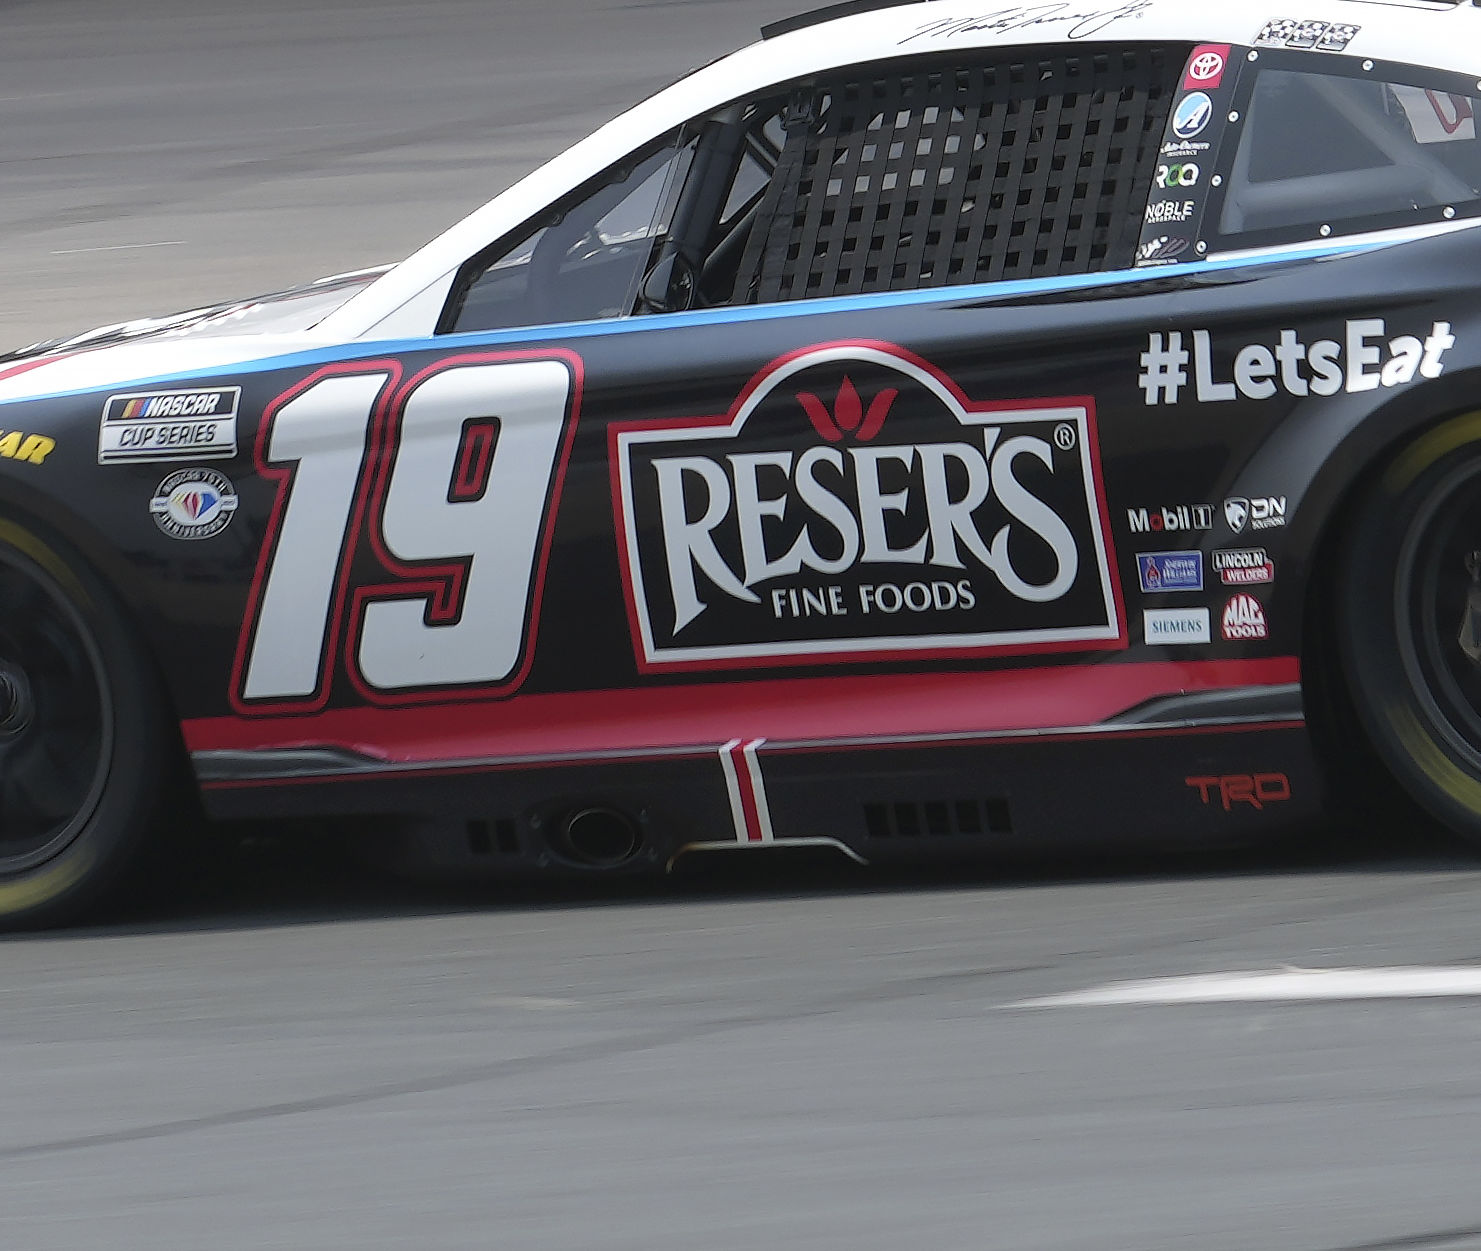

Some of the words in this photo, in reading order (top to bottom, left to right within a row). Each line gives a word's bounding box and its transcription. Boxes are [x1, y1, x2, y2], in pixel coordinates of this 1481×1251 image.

[1138, 318, 1456, 406] #LetsEat
[147, 394, 219, 418] NASCAR
[120, 427, 155, 447] CUP
[157, 423, 217, 445] SERIES
[238, 358, 572, 702] 19
[650, 427, 1080, 637] RESER'S
[1126, 504, 1192, 533] Mobil
[1193, 505, 1211, 529] 1
[1215, 552, 1265, 569] LINCOLN
[1226, 566, 1270, 583] WELDERS
[771, 585, 847, 618] FINE
[858, 580, 976, 615] FOODS
[1223, 594, 1266, 627] MAC
[1152, 620, 1203, 635] SIEMENS
[1223, 624, 1266, 638] TOOLS
[1185, 773, 1291, 811] TRD
